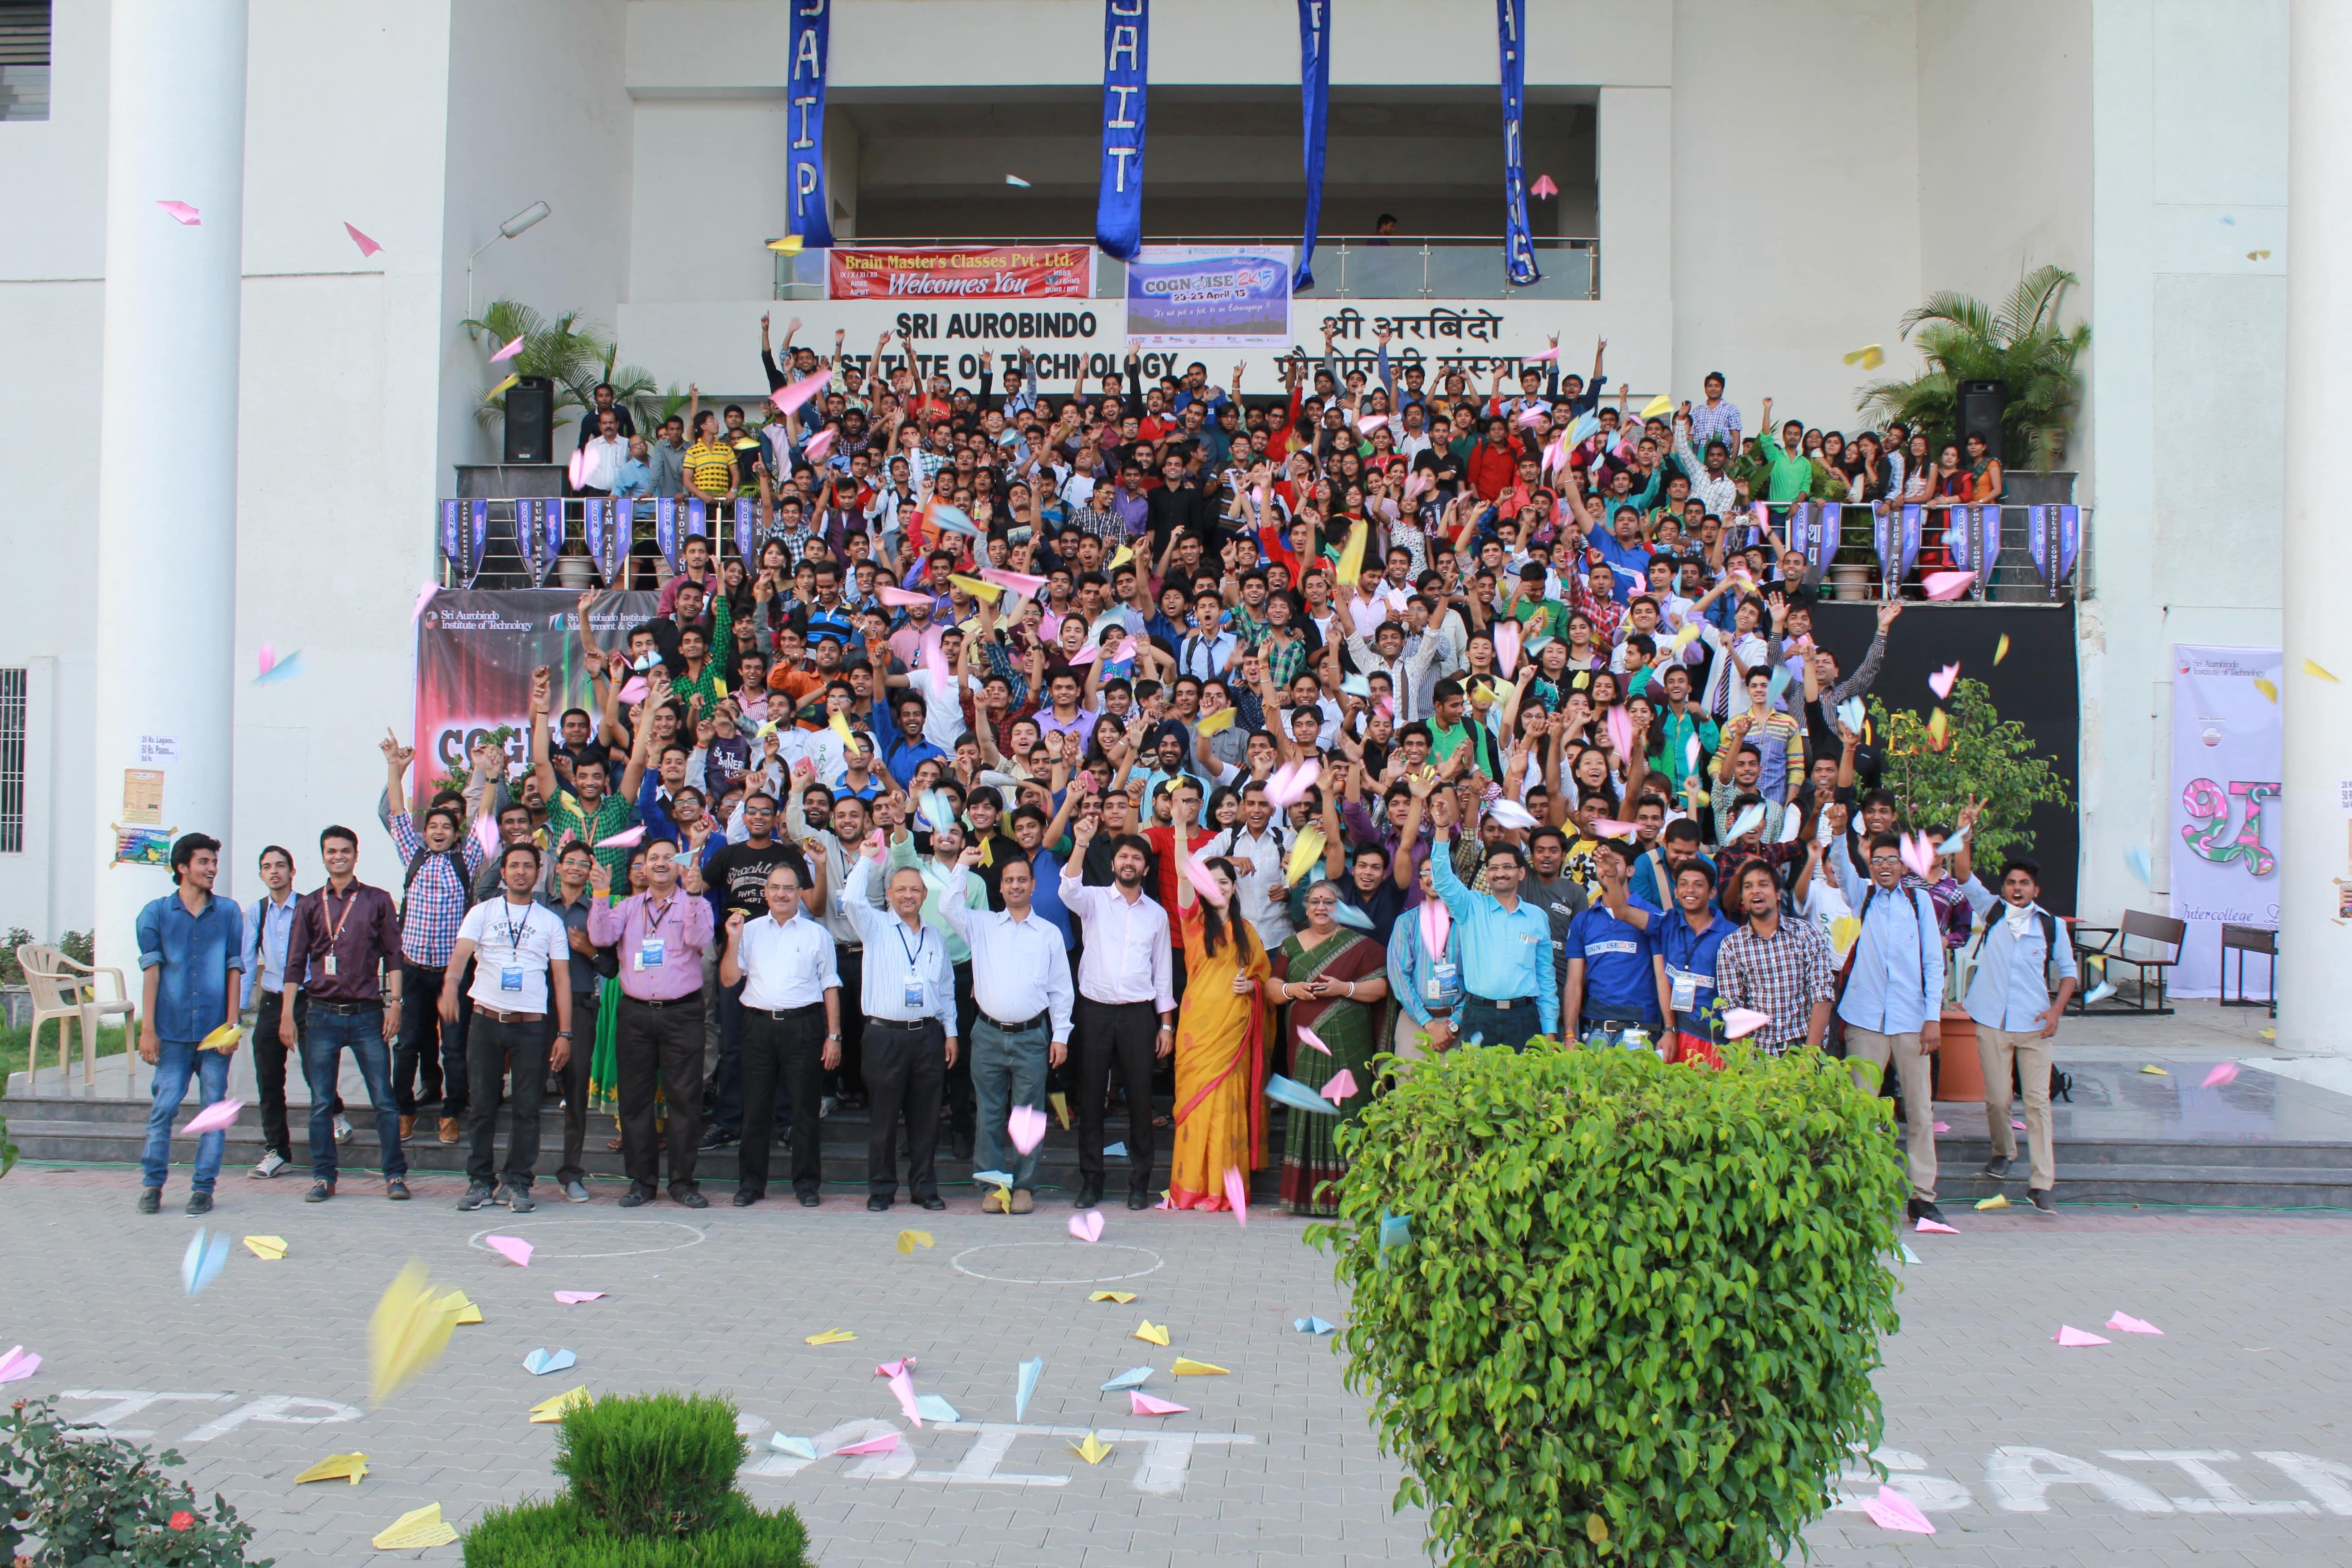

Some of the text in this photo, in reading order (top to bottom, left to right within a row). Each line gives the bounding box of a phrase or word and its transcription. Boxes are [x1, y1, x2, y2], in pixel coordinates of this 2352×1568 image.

[846, 253, 1074, 270] Brain Master's Classes Pvt. Ltd.
[888, 271, 1030, 296] Welcomes You
[896, 311, 1097, 339] SRI AUROBINDO
[605, 500, 613, 525] JAM
[1890, 554, 1900, 595] MAKERS
[441, 610, 500, 620] Sri Aurobindo
[568, 613, 578, 622] Sri
[620, 613, 651, 622] Institute
[441, 620, 533, 632] Institute of Technology
[618, 622, 625, 630] &
